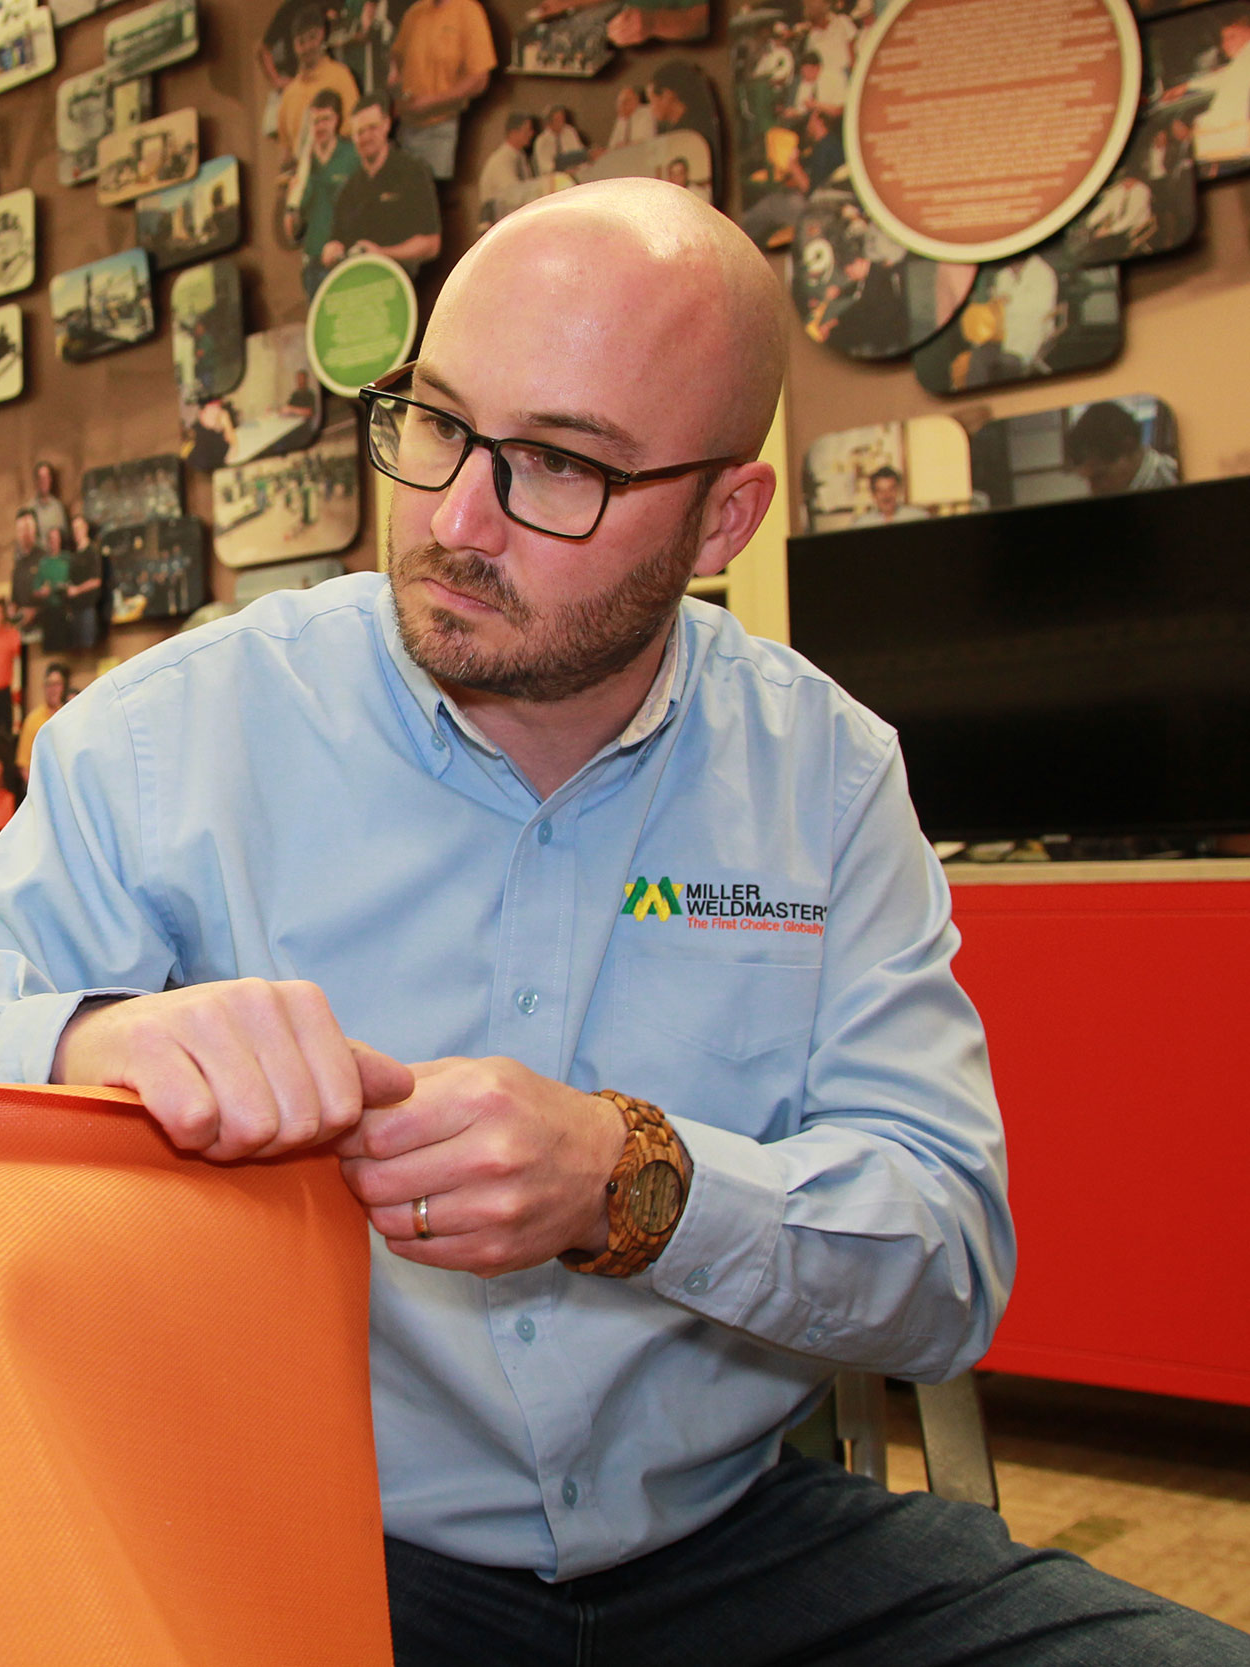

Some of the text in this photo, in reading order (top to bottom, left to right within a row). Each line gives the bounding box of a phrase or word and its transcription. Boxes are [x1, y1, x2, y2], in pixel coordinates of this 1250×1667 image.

[686, 883, 760, 900] MILLER
[686, 900, 824, 921] WELDMASTER
[687, 915, 824, 937] The First Choice Globally
